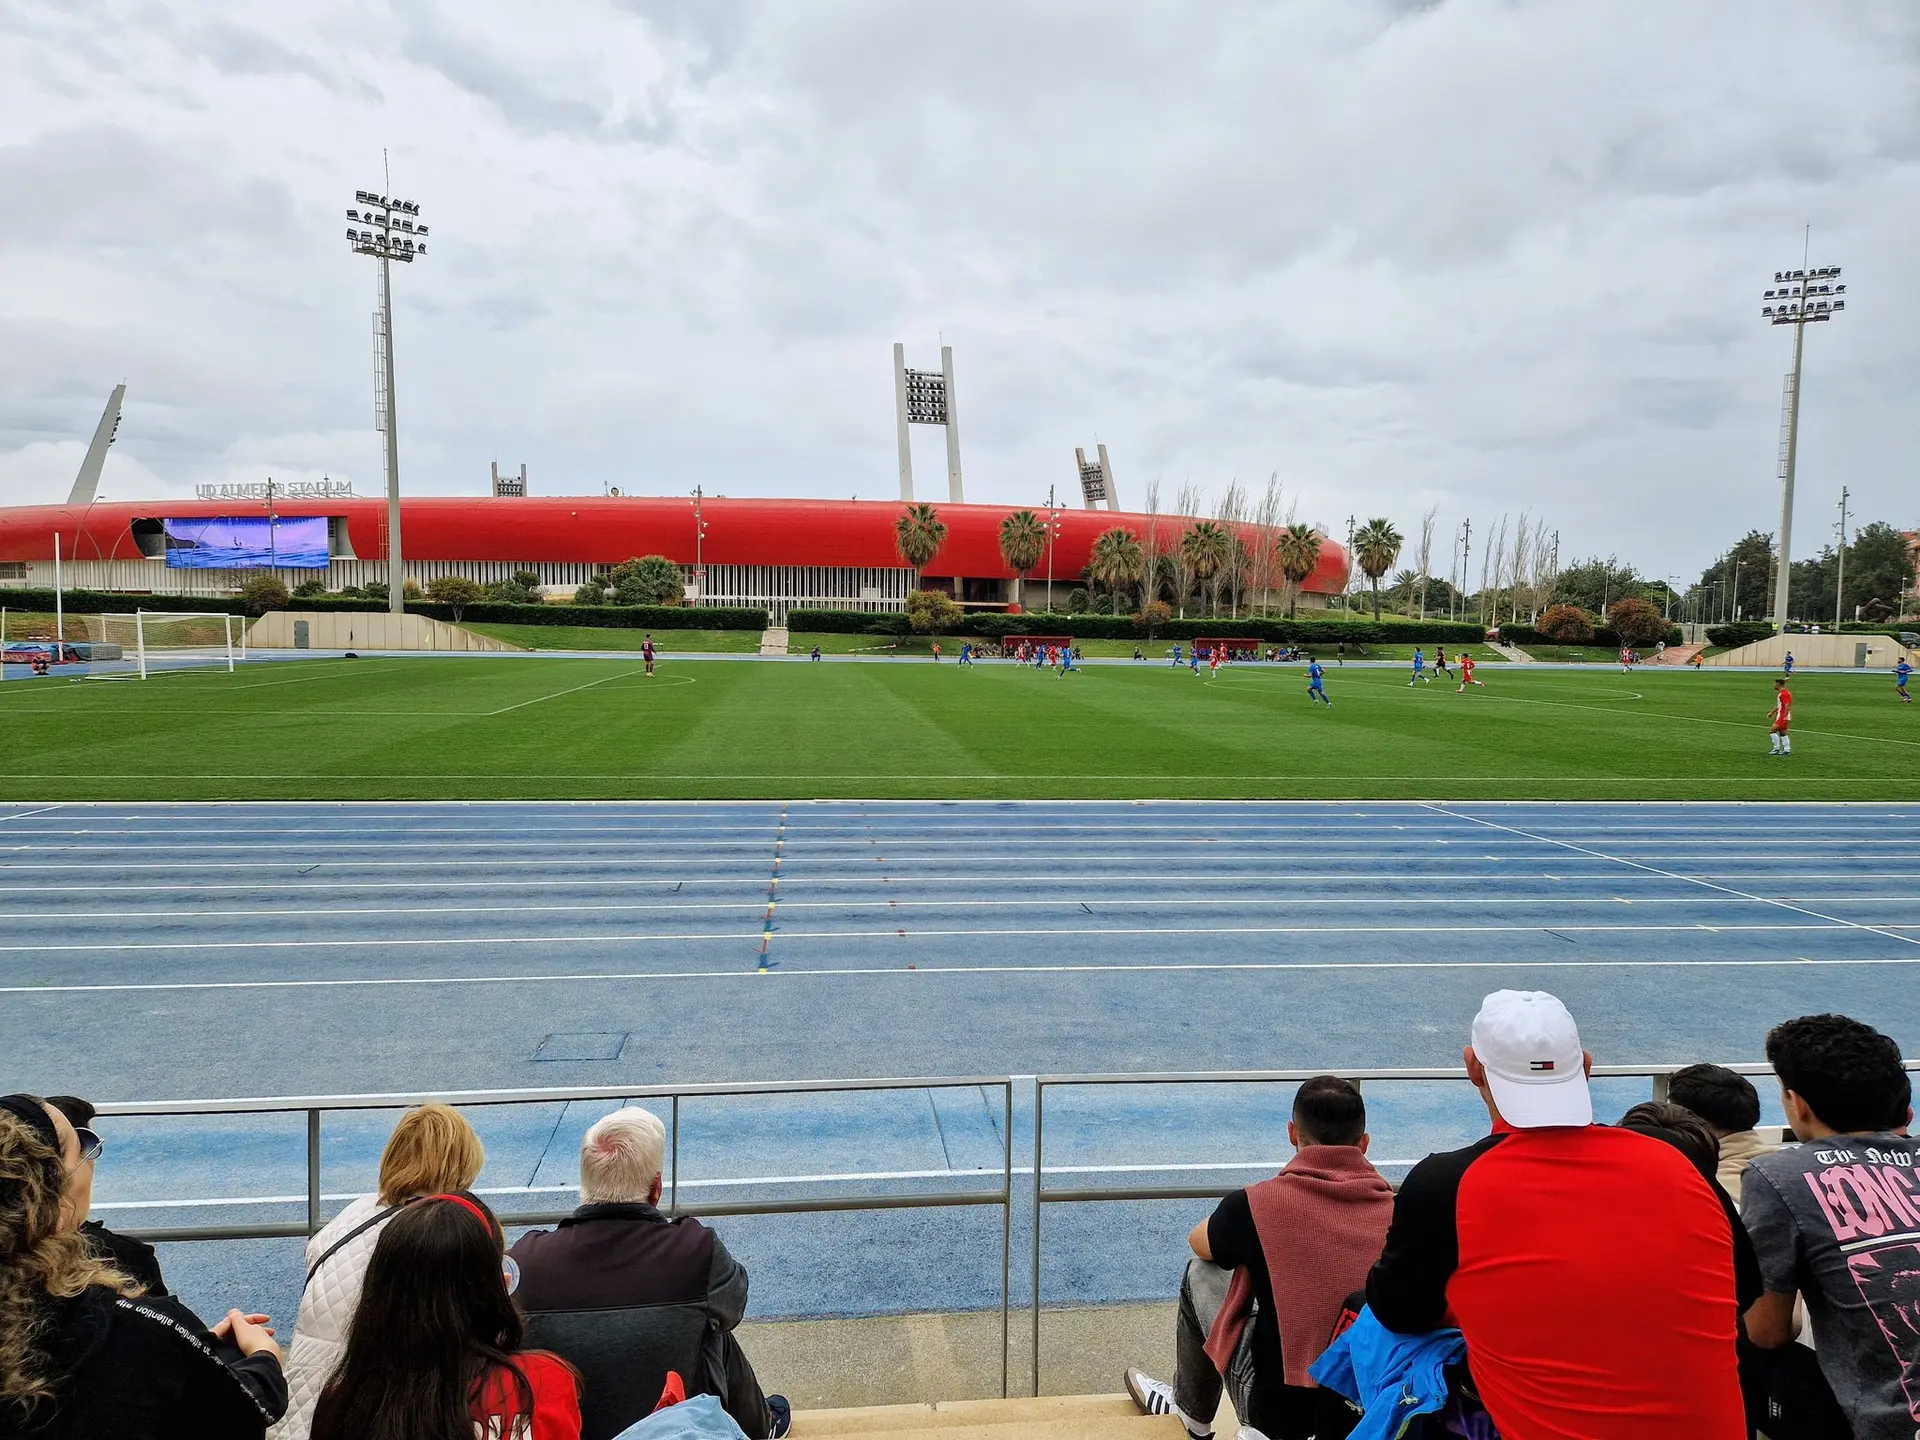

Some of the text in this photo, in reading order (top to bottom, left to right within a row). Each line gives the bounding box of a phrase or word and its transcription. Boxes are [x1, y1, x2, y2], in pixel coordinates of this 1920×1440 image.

[195, 481, 352, 496] UD ALMERA STADIUM
[1863, 1147, 1912, 1167] New
[135, 1304, 174, 1327] attention
[174, 1323, 203, 1349] attention
